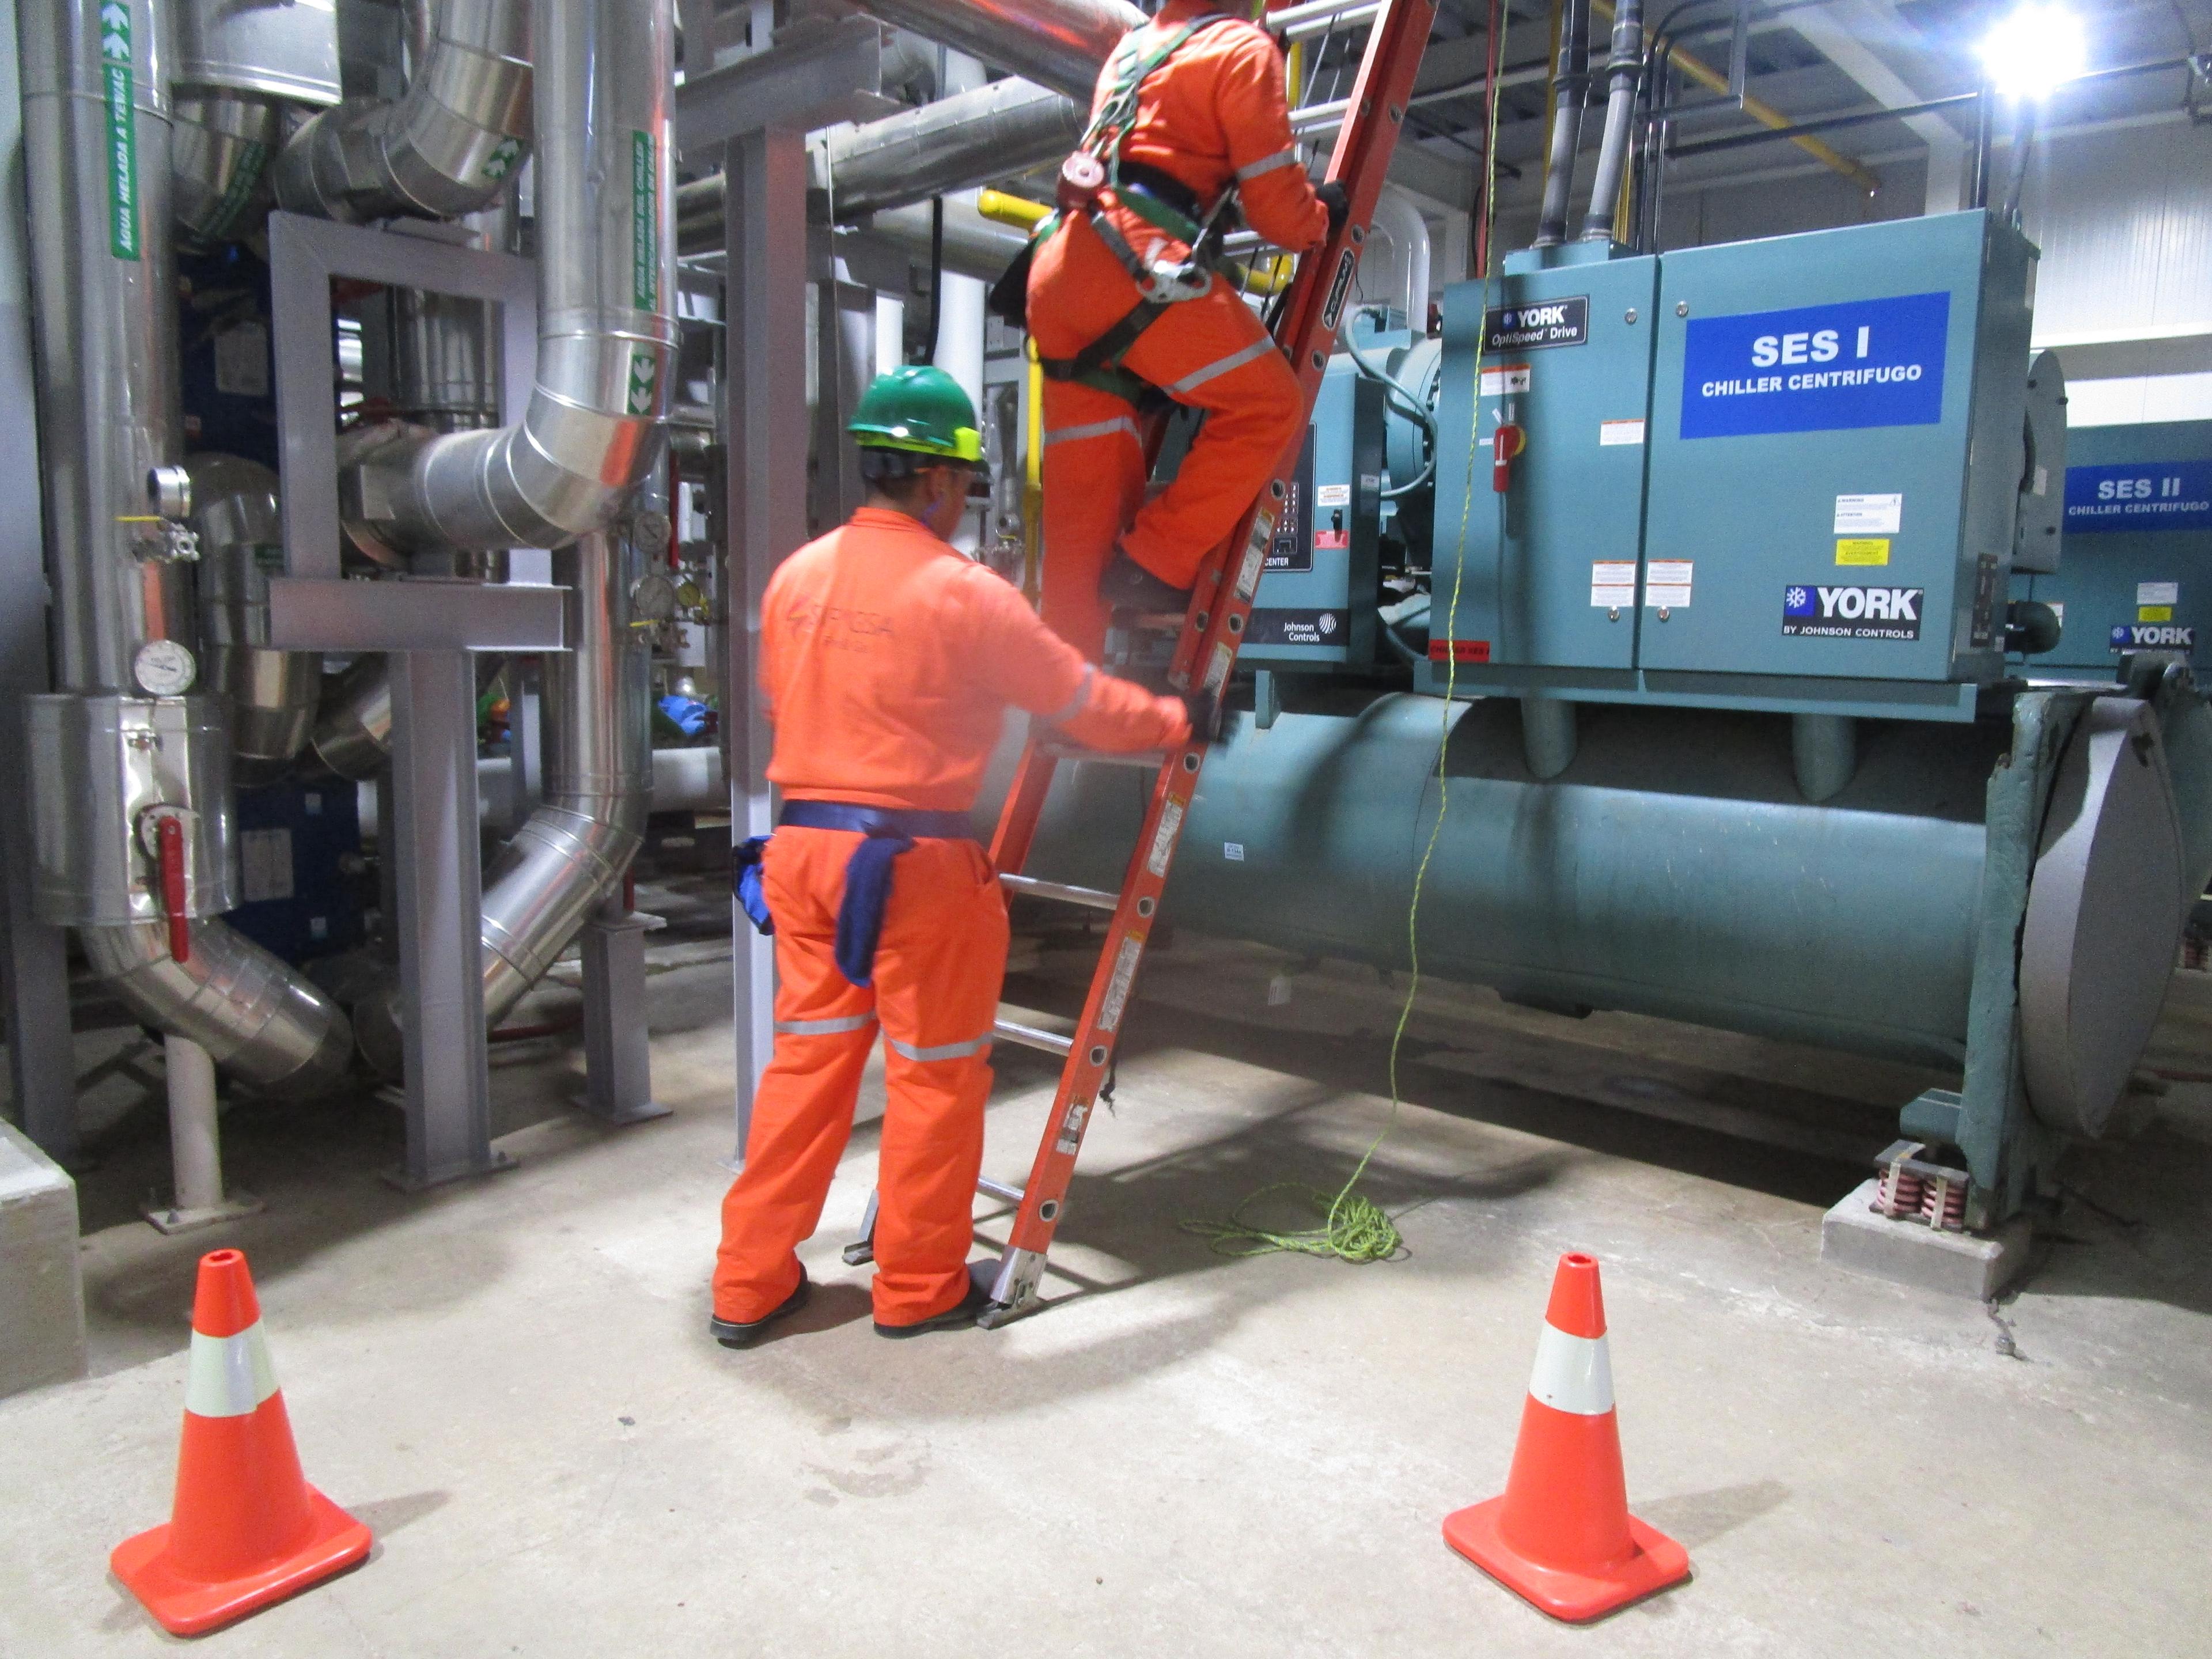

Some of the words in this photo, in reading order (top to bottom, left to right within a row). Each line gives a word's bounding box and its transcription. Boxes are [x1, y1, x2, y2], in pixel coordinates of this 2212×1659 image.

[116, 141, 131, 205] HELADA
[119, 207, 132, 252] AGUA
[1518, 305, 1565, 328] YORK
[1492, 329, 1544, 347] OptiSpeed
[1550, 325, 1577, 339] Drive
[1751, 329, 1839, 368] SES
[1856, 326, 1869, 359] I
[1702, 376, 1782, 397] CHILLER
[1788, 364, 1922, 391] CENTRIFUGO
[2097, 479, 2152, 499] SES
[2161, 478, 2181, 497] II
[2069, 505, 2121, 516] CHILLER
[2124, 501, 2210, 513] CENTRIFUGO
[1817, 586, 1918, 620] YORK
[1283, 622, 1315, 632] Johnson
[1289, 632, 1320, 642] Controls
[1783, 625, 1797, 634] BY
[1800, 626, 1851, 637] JOHNSON
[1855, 628, 1914, 639] CONTROLS
[2131, 626, 2192, 645] YORK
